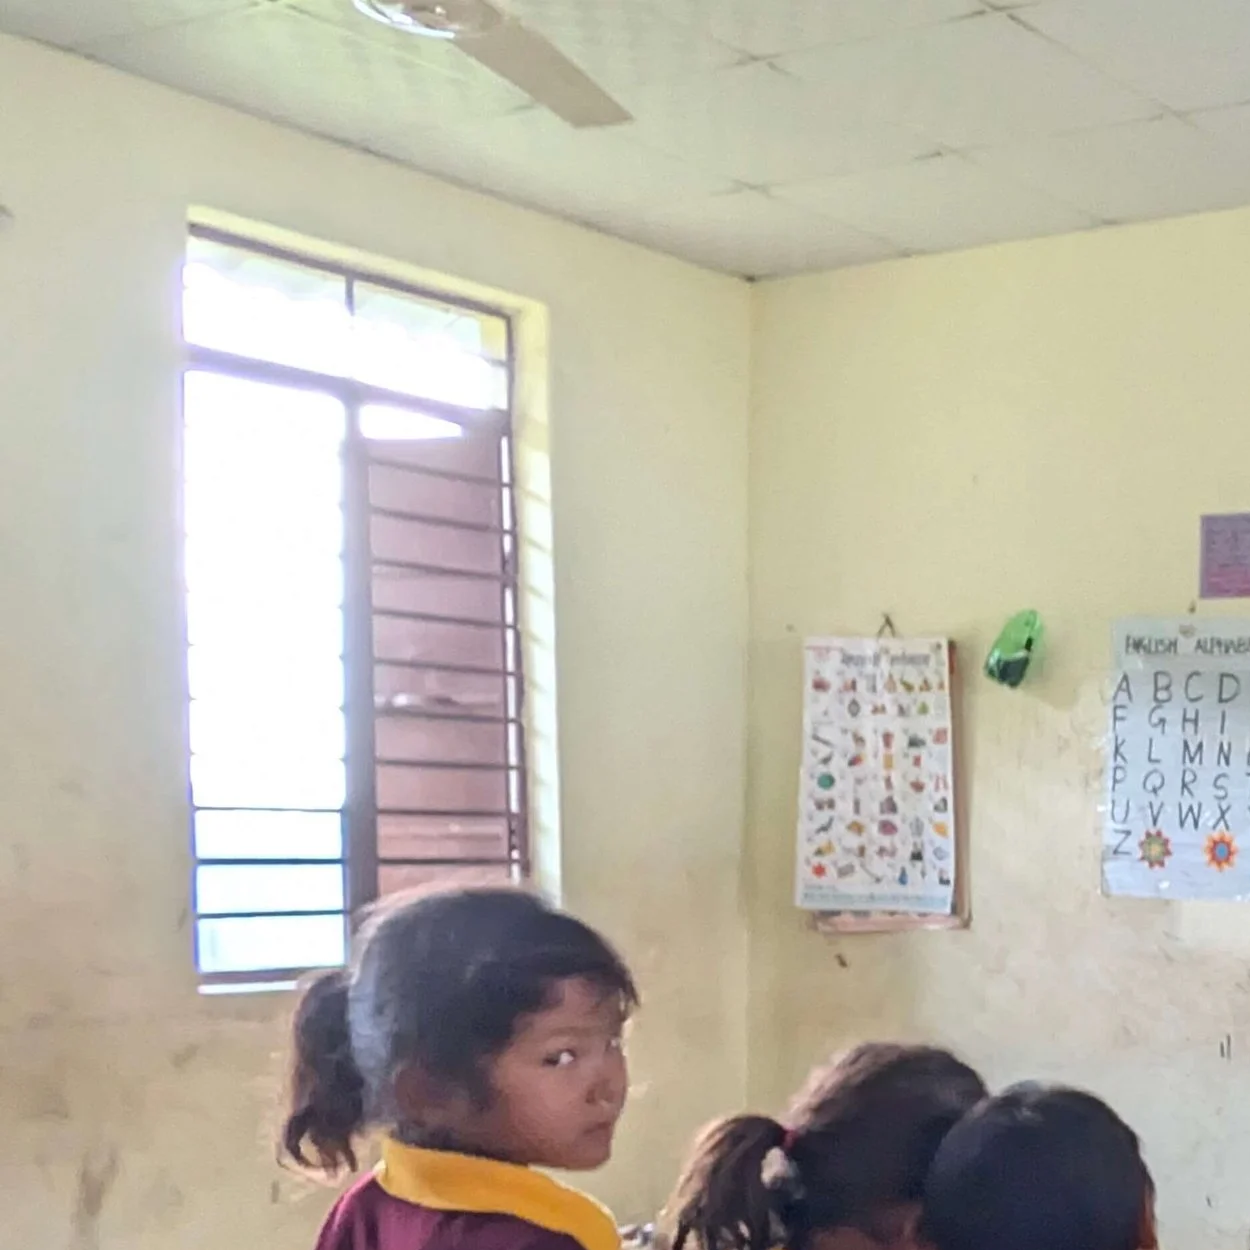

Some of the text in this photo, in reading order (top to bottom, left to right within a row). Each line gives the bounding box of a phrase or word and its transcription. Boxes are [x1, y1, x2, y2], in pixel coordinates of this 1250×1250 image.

[1126, 635, 1178, 654] ENGLISH
[1113, 672, 1133, 702] A
[1153, 670, 1173, 706] B
[1184, 670, 1203, 703] C
[1218, 672, 1240, 704] D
[1113, 706, 1127, 731] F
[1148, 702, 1169, 734] G
[1182, 708, 1199, 735] H
[1113, 734, 1127, 763] K
[1147, 737, 1161, 764] L
[1182, 739, 1203, 765] M
[1217, 741, 1231, 766] N
[1112, 764, 1126, 792] P
[1142, 769, 1165, 797] Q
[1181, 769, 1197, 797] R
[1213, 773, 1229, 803] S
[1112, 800, 1131, 822] U
[1149, 801, 1164, 827] V
[1178, 802, 1202, 830] W
[1212, 802, 1231, 831] X
[1110, 829, 1132, 859] Z
